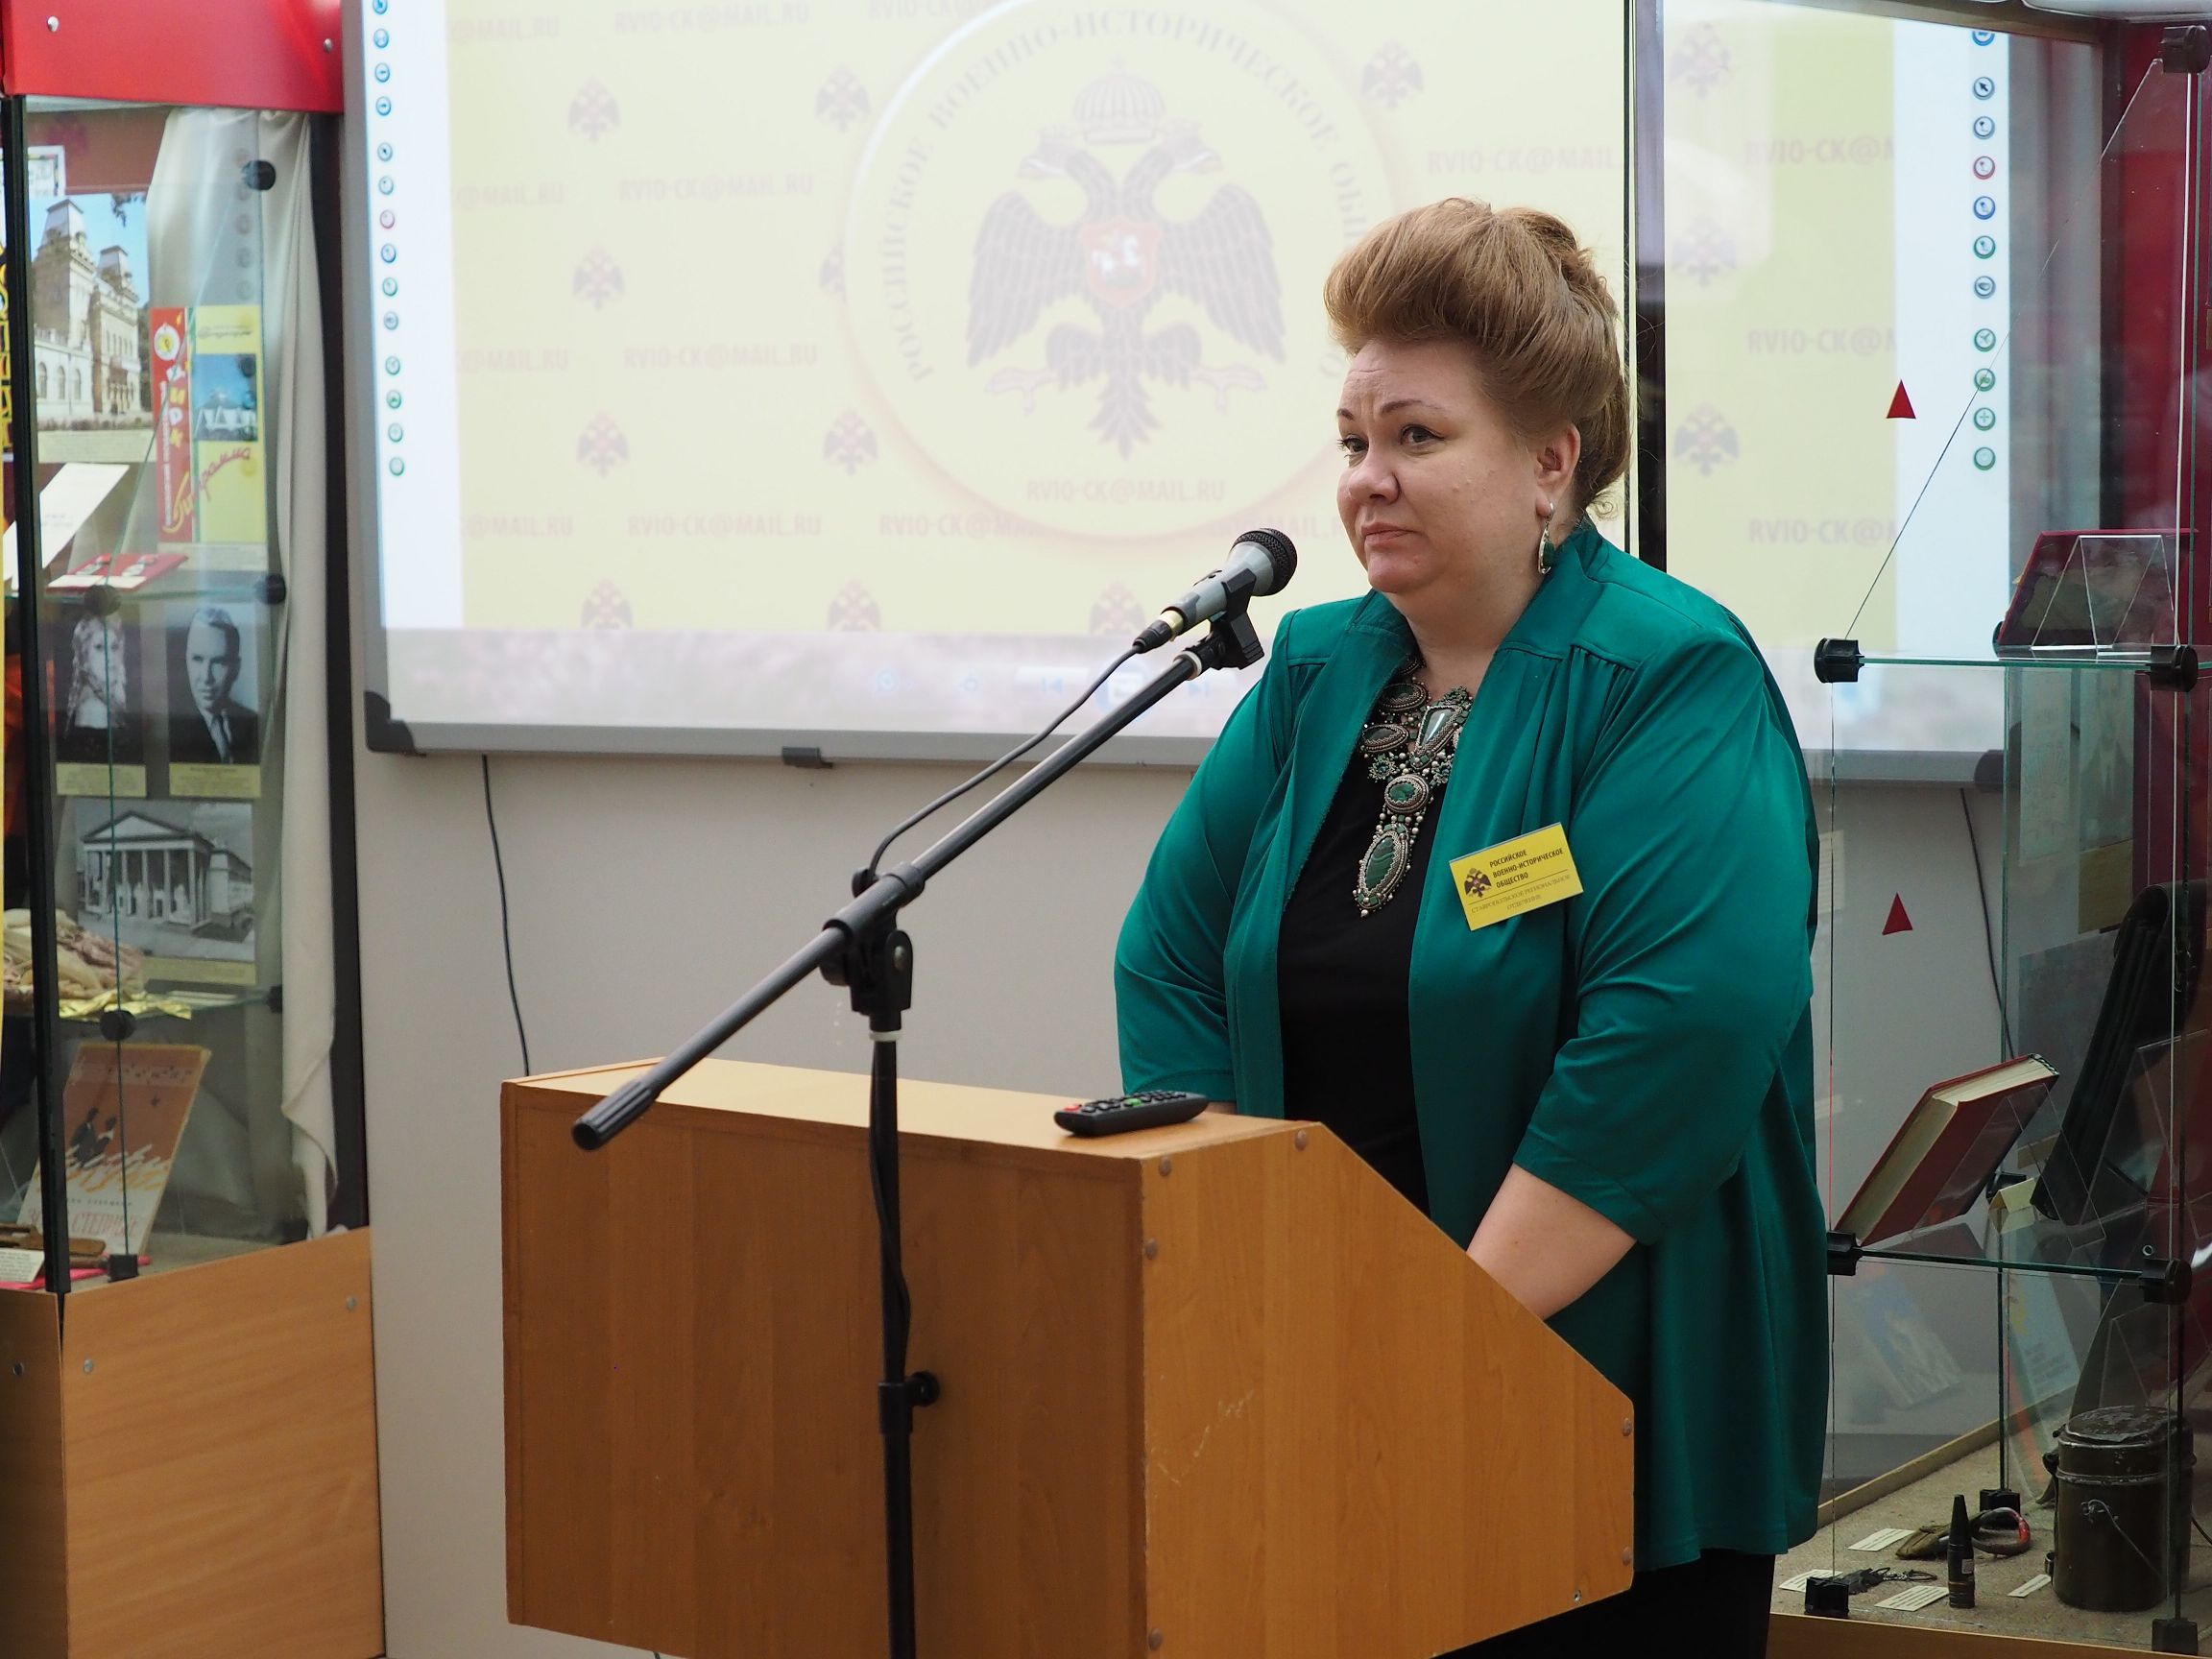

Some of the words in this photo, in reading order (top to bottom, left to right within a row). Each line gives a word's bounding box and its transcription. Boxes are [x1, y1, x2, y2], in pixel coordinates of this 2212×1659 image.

[623, 344, 818, 371] RVIO-CK@MAIL.RU
[1025, 479, 1226, 503] RVIO-CK@MAIL.RU
[627, 513, 823, 539] RVIO-CK@MAIL.RU
[1489, 849, 1527, 868] РОССИЙСКОЕ
[1492, 848, 1565, 878] ВОЕННО-ИСТОРИЧЕСКОЕ
[1495, 872, 1529, 889] ОБЩЕСТВО
